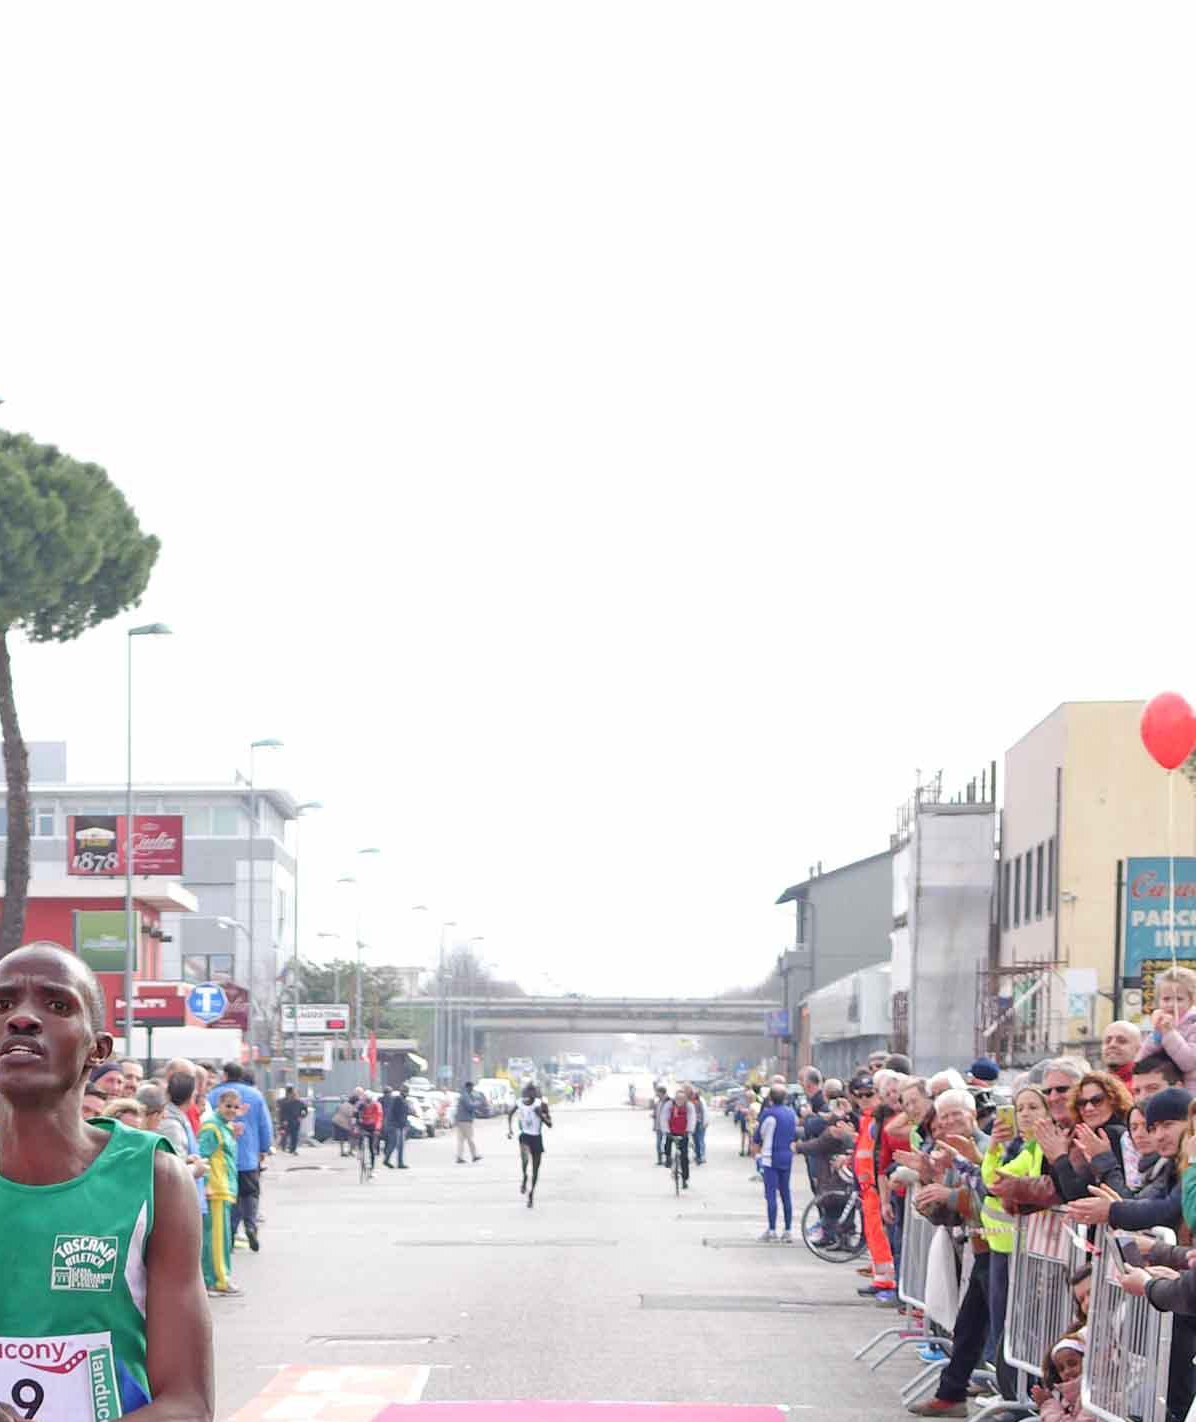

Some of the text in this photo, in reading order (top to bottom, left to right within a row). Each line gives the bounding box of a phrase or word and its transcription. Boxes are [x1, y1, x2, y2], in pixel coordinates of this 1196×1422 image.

[72, 851, 119, 873] 1878
[1155, 929, 1196, 948] INT
[56, 1237, 116, 1262] TOSCANA
[65, 1252, 106, 1269] ATLETICA
[11, 1378, 44, 1420] 9
